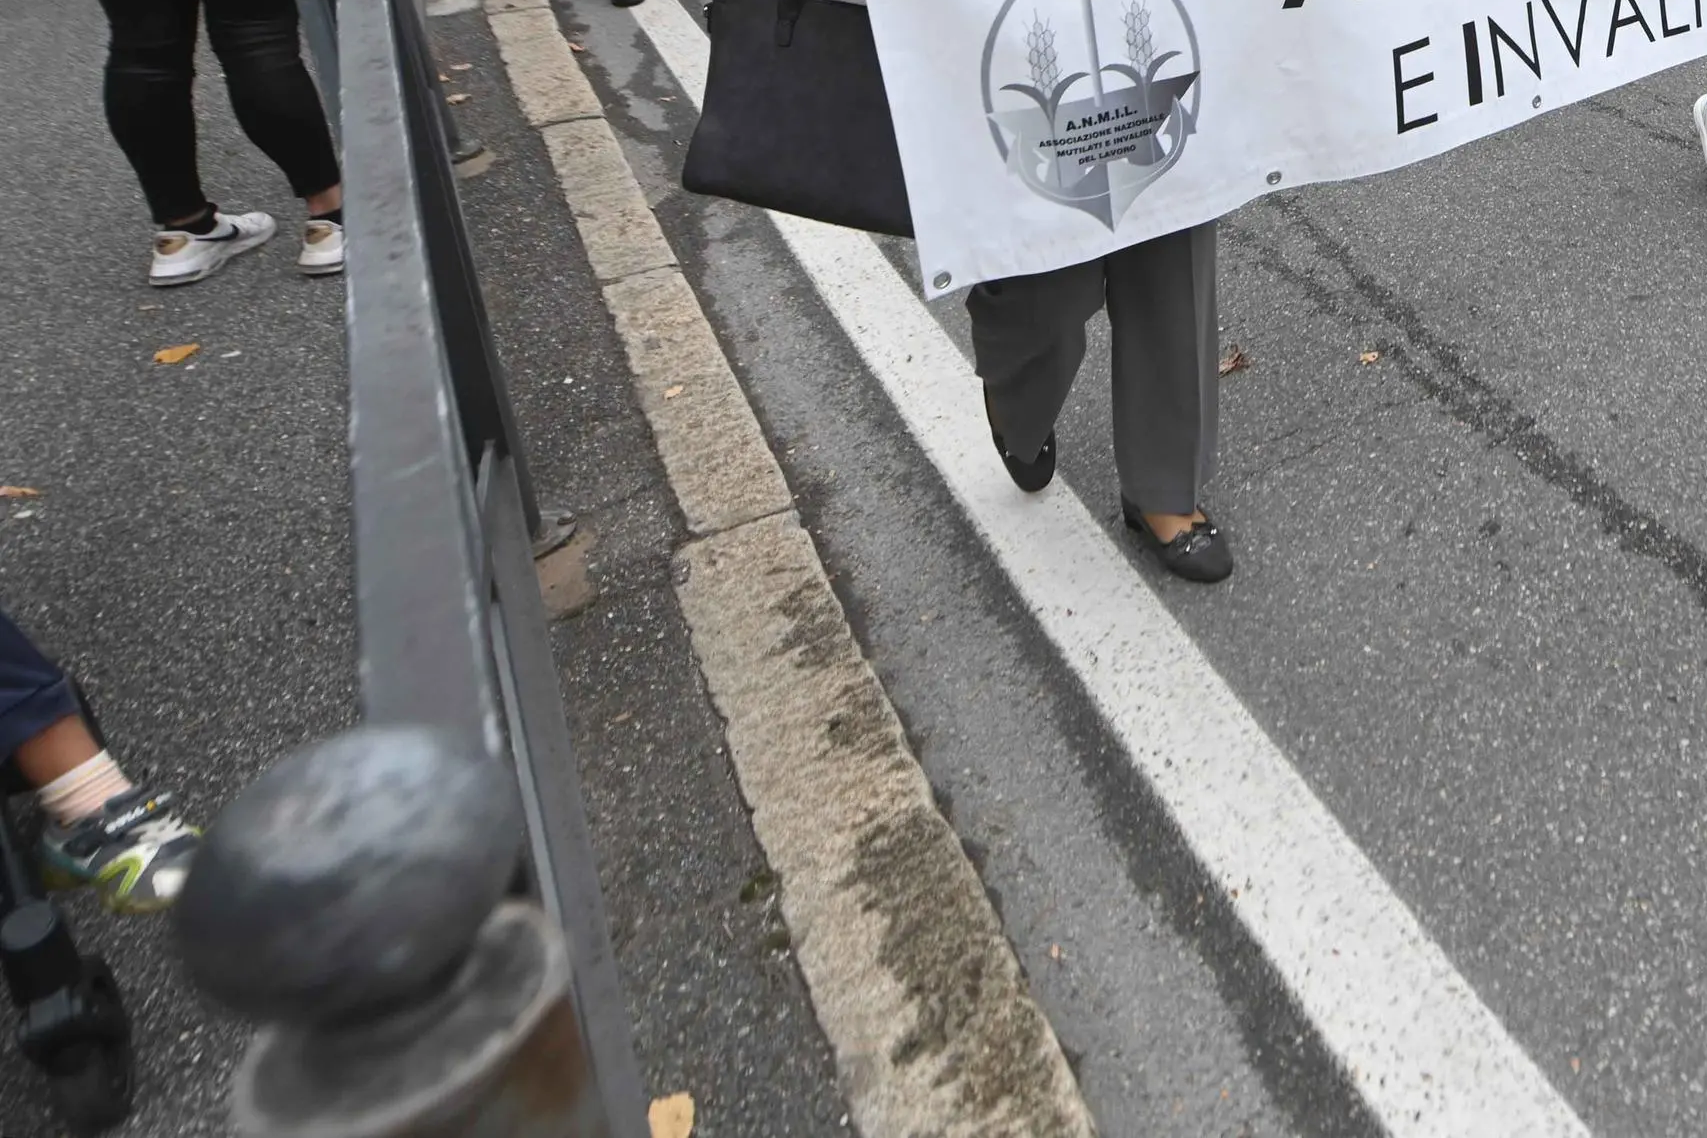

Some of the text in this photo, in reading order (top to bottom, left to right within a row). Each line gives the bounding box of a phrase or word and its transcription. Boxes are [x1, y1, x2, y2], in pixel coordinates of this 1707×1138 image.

[1392, 35, 1439, 135] E
[1039, 112, 1165, 148] ASSOCIAZIONE NAZIONALE
[1066, 105, 1138, 132] A.N.M.I.L.
[1056, 128, 1153, 158] MUTILATI E INVALIDI
[1078, 144, 1137, 166] DEL LAVORO
